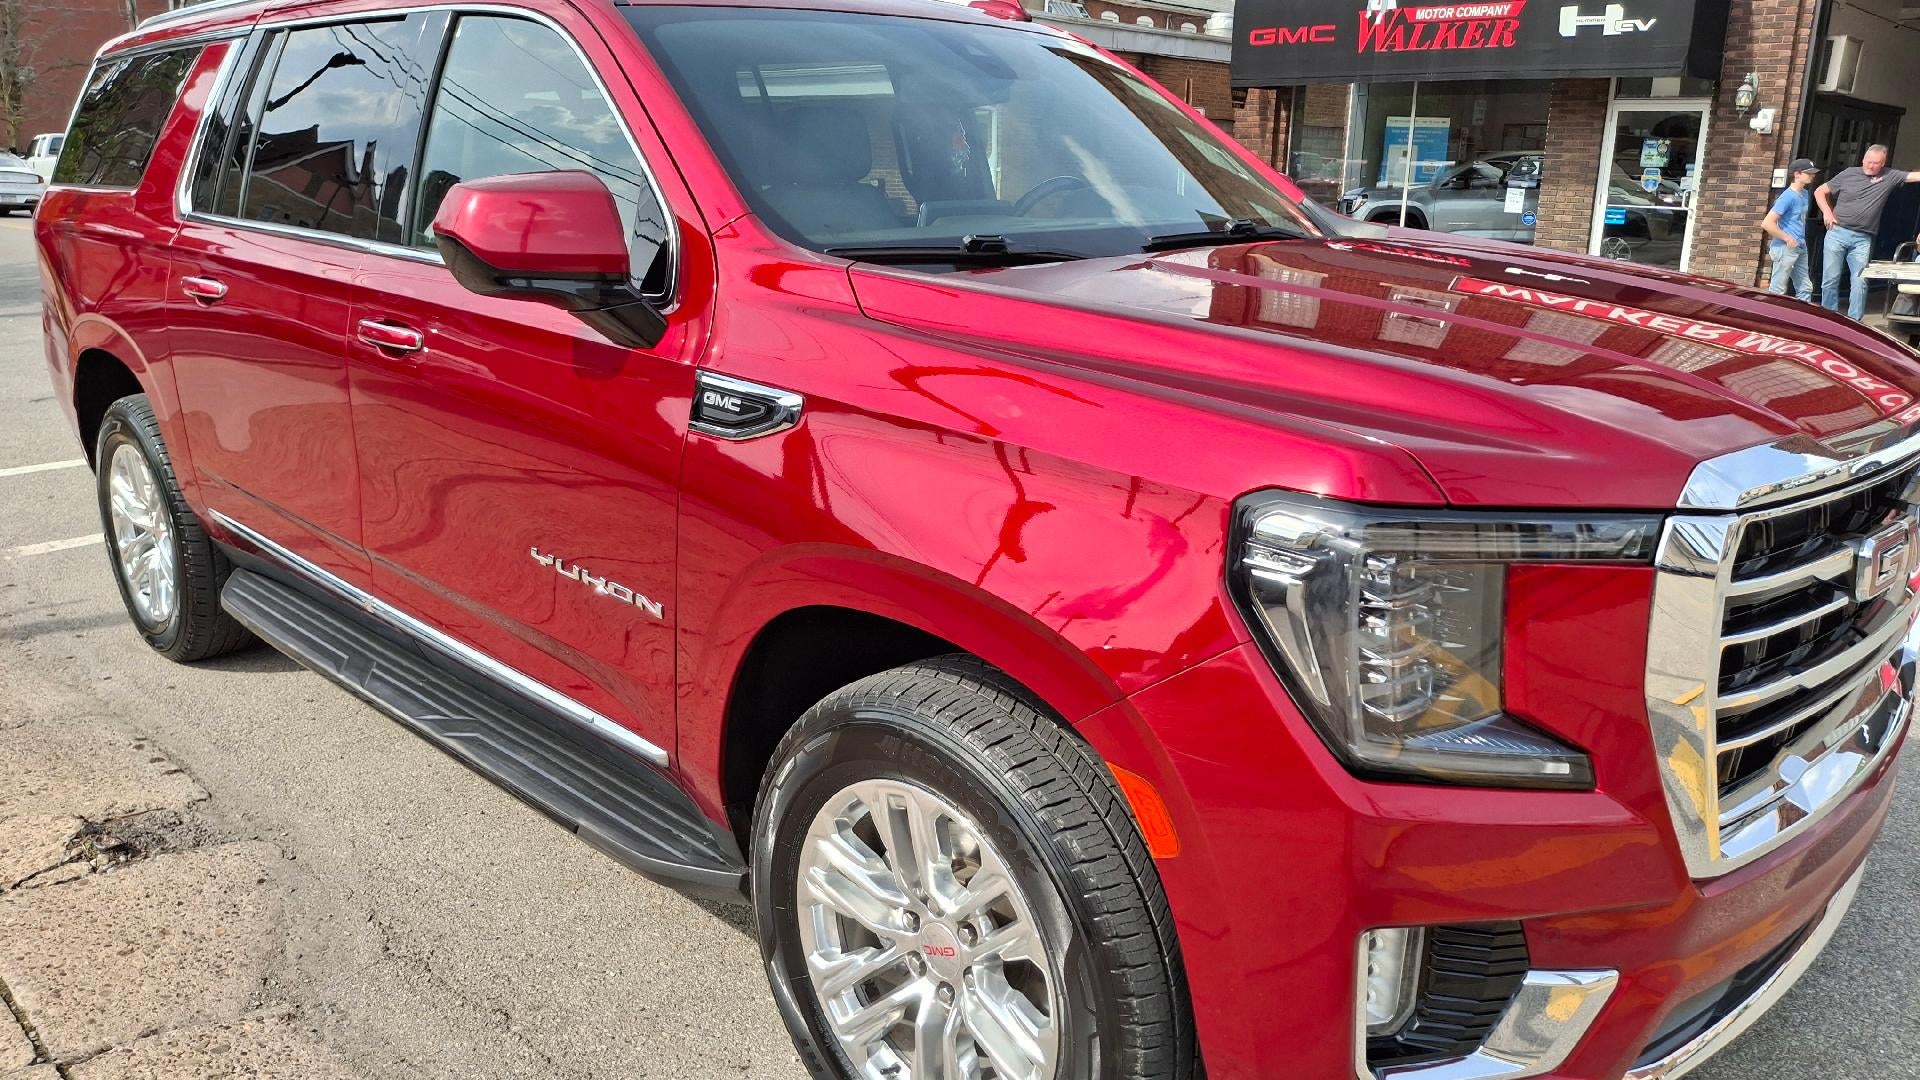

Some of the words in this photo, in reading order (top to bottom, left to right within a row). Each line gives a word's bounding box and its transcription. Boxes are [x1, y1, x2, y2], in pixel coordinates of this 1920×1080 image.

[1415, 8, 1455, 20] MOTOR
[1456, 4, 1512, 18] COMPANY
[1249, 24, 1336, 46] GMC
[1358, 8, 1520, 53] WALKER
[703, 391, 742, 412] GMC
[530, 546, 665, 620] YUKON
[923, 944, 956, 957] GMC
